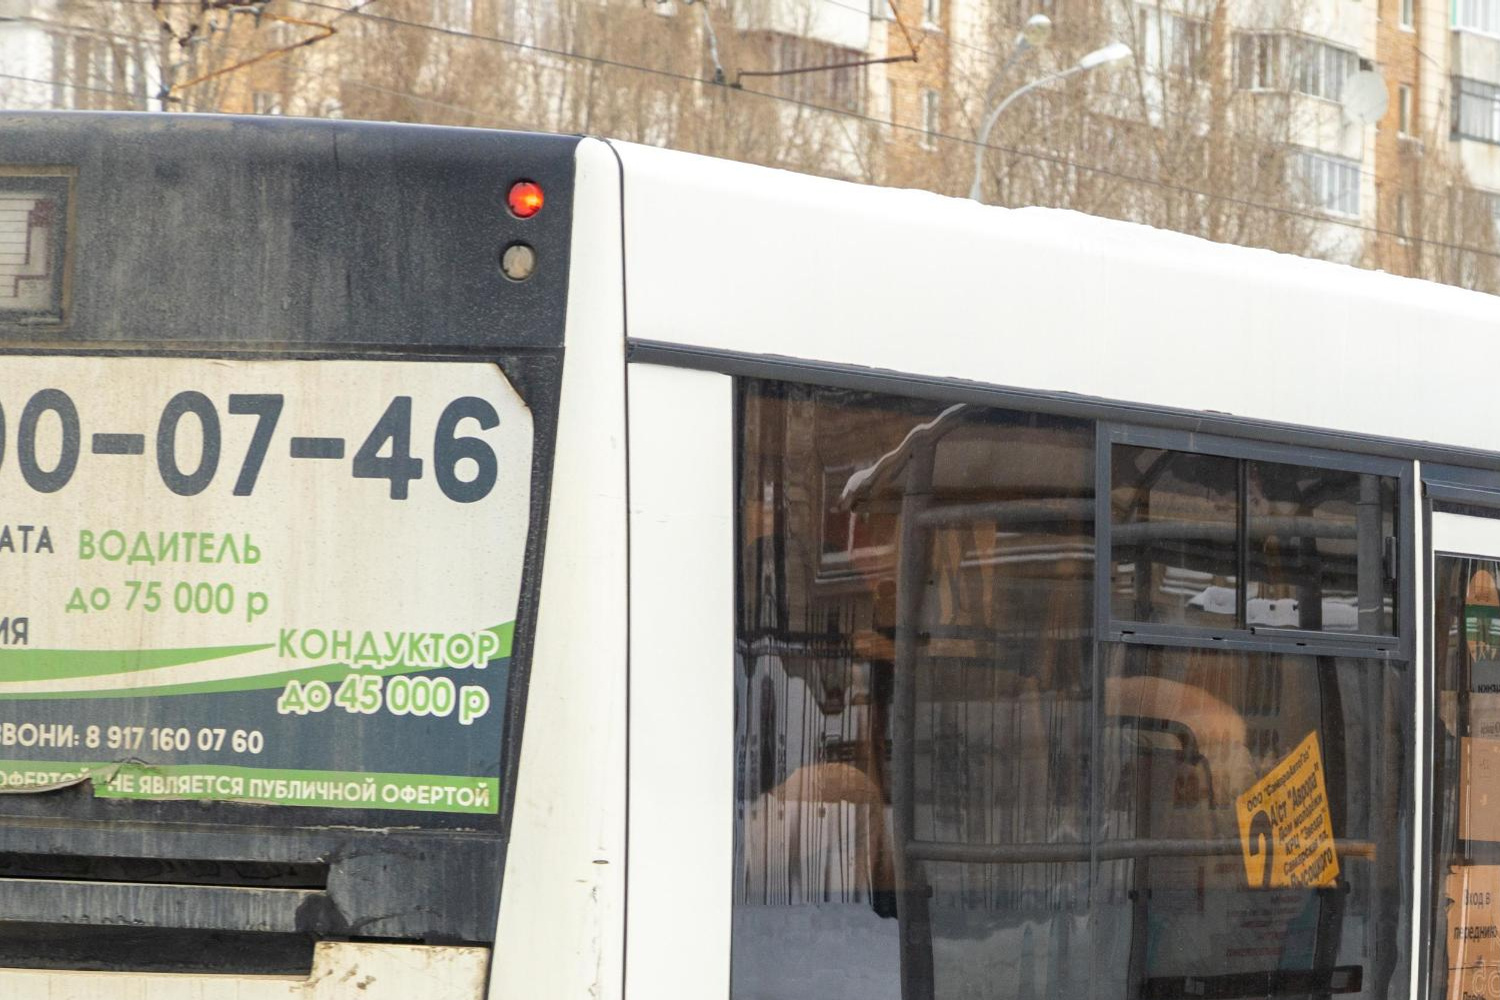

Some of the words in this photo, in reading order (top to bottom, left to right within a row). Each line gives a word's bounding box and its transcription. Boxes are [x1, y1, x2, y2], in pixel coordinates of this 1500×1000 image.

[0, 387, 500, 503] 0-07-46
[79, 529, 262, 565] ВОДИТЕЛЬ
[65, 587, 111, 613] до
[124, 580, 162, 612] 75
[174, 582, 235, 614] 000
[247, 591, 268, 623] р
[278, 628, 496, 665] КОНДУКТОР
[281, 682, 329, 711] до
[338, 678, 379, 709] 45
[390, 680, 452, 713] 000
[463, 689, 487, 721] р
[0, 722, 79, 748] ВОНИ:
[85, 725, 100, 748] 8
[107, 725, 145, 750] 917
[151, 728, 190, 751] 160
[197, 728, 227, 752] 07
[232, 730, 264, 754] 60
[108, 774, 133, 793] НЕ
[139, 774, 244, 796] ЯВЛЯЕТСЯ
[250, 778, 377, 802] ПУБЛИЧНОЙ
[382, 782, 489, 807] ОФЕРТОЙ
